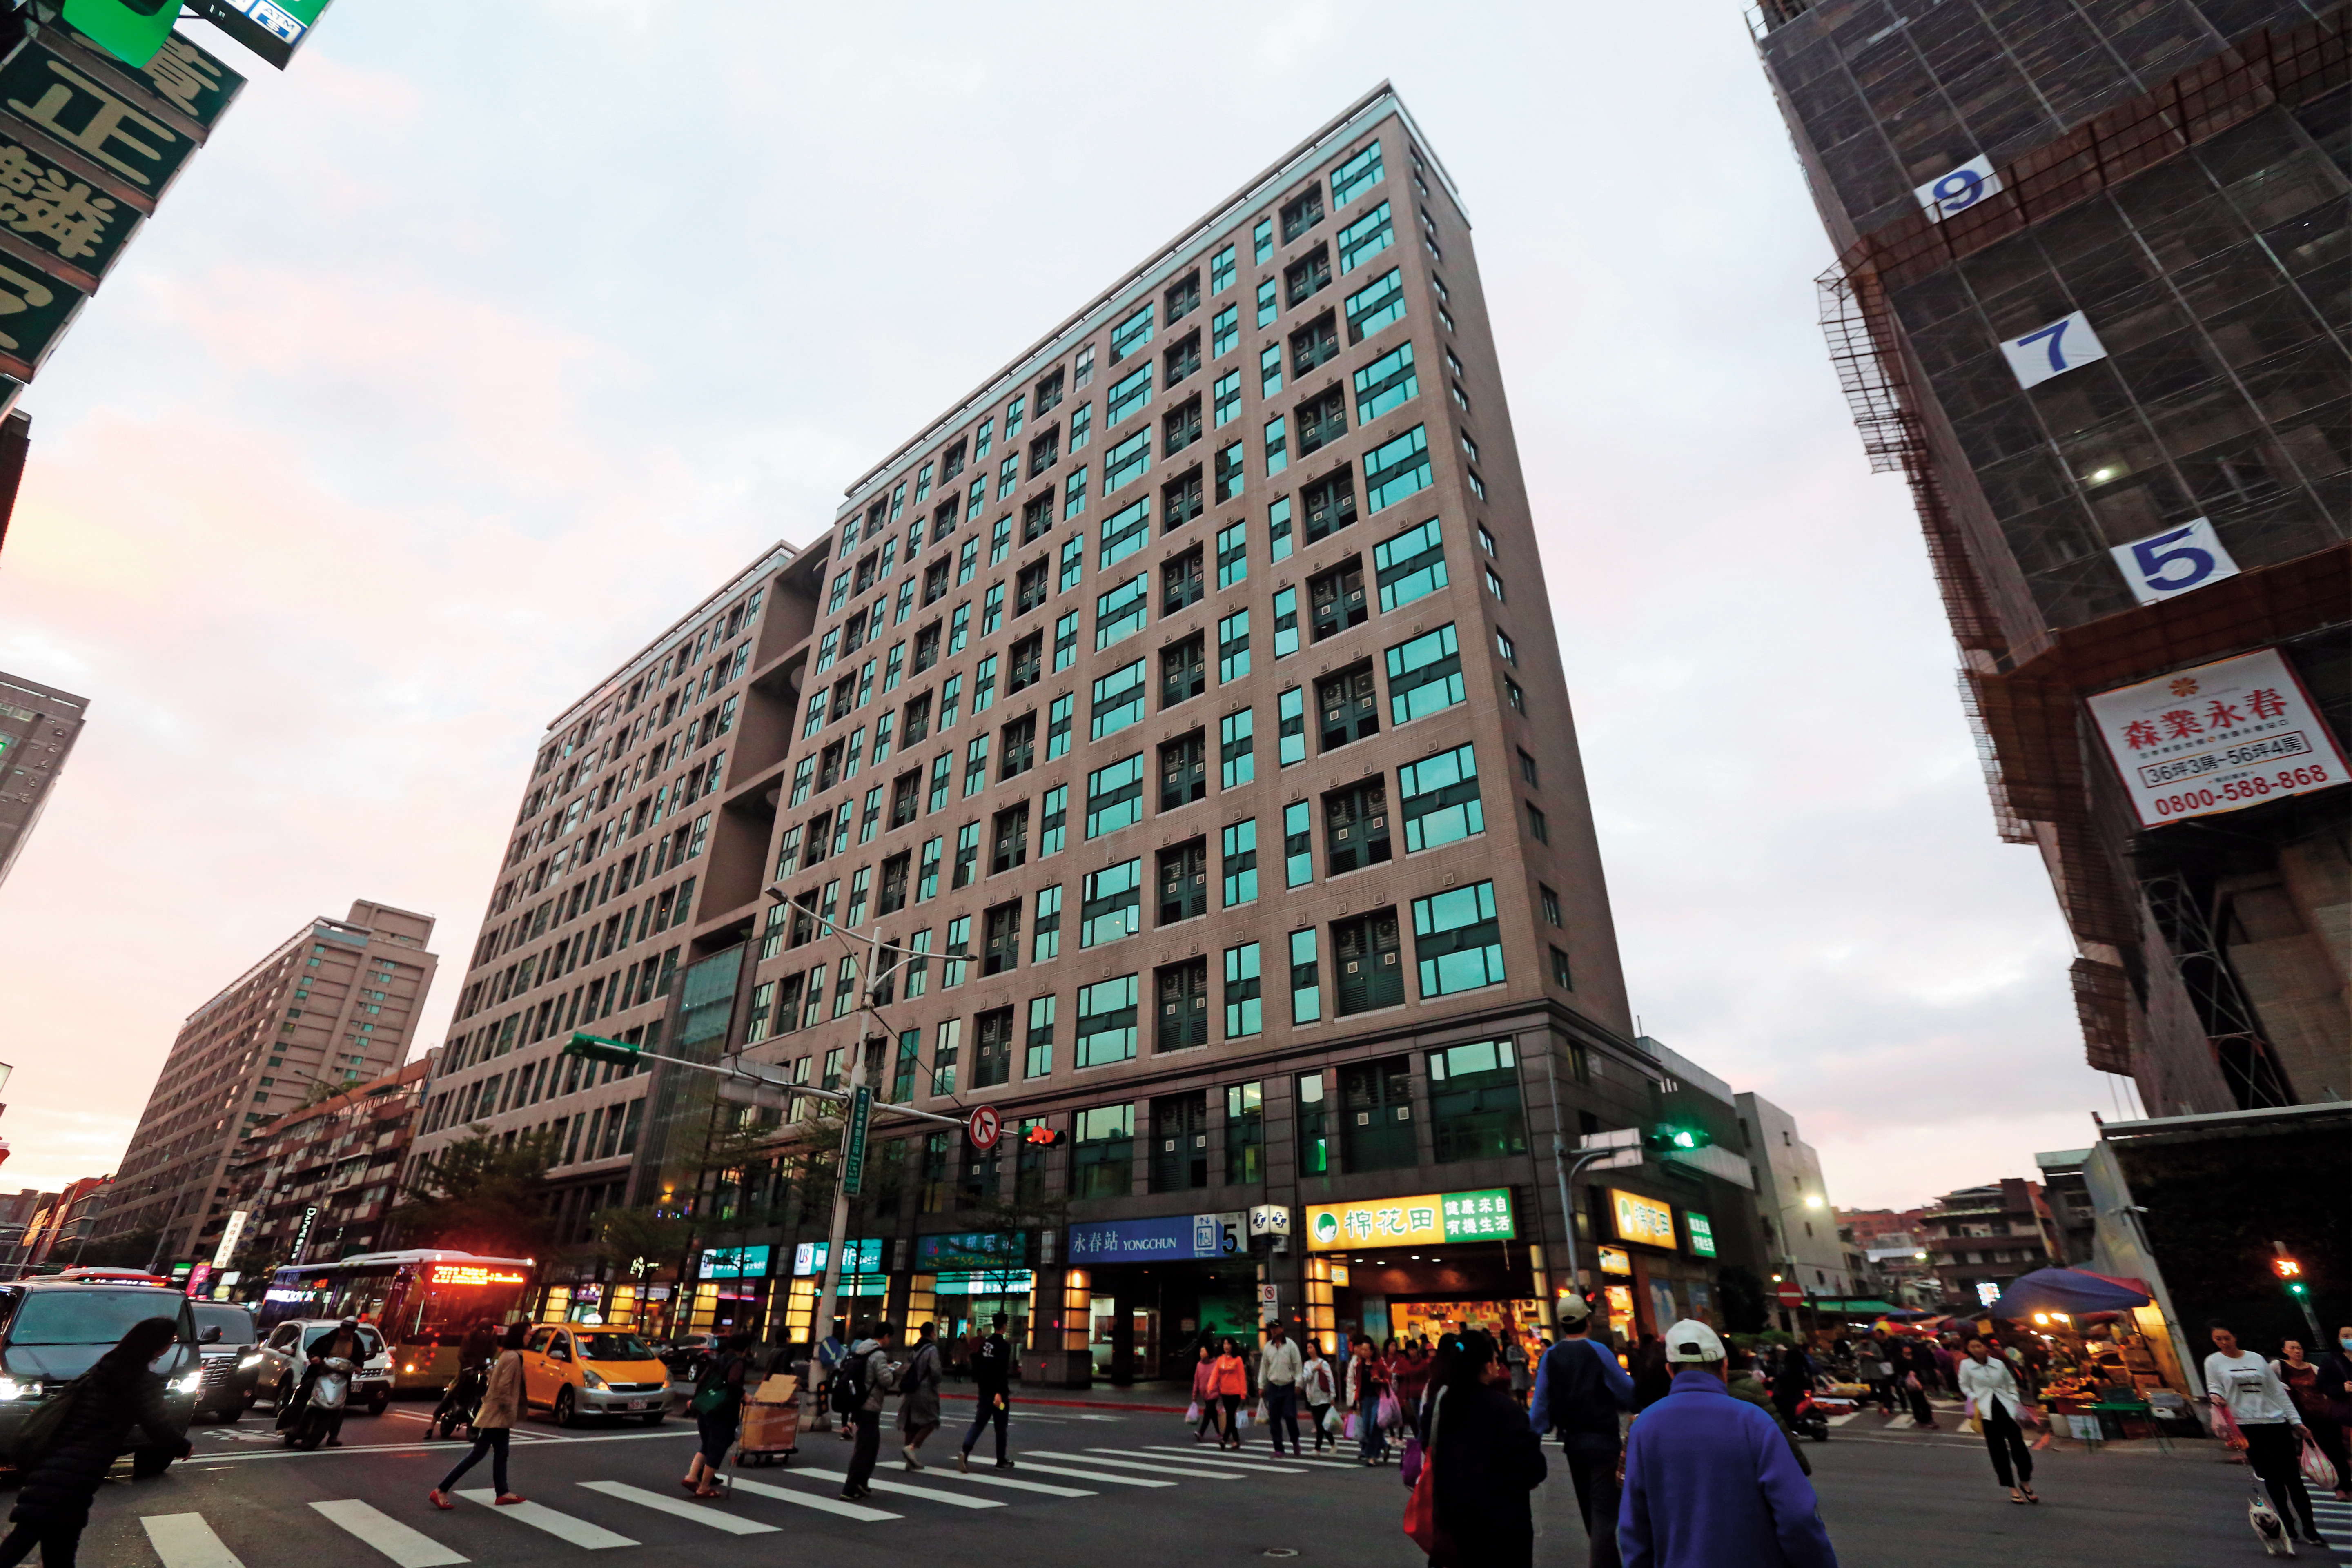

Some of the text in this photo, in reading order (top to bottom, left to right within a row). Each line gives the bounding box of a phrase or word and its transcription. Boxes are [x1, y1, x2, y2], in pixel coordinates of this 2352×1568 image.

[263, 7, 295, 30] ATM
[1933, 169, 1984, 210] 9
[2016, 320, 2071, 372] 7
[2131, 526, 2216, 591] 5
[2120, 687, 2287, 751] 森業永春
[2155, 764, 2328, 816] 0800-588-868
[1444, 1196, 1507, 1216] 健康來自
[1222, 1223, 1238, 1253] 5
[1344, 1207, 1434, 1241] 棉花田
[1446, 1215, 1510, 1235] 有機生活
[1073, 1230, 1176, 1253] 永春站 YONGCHUN
